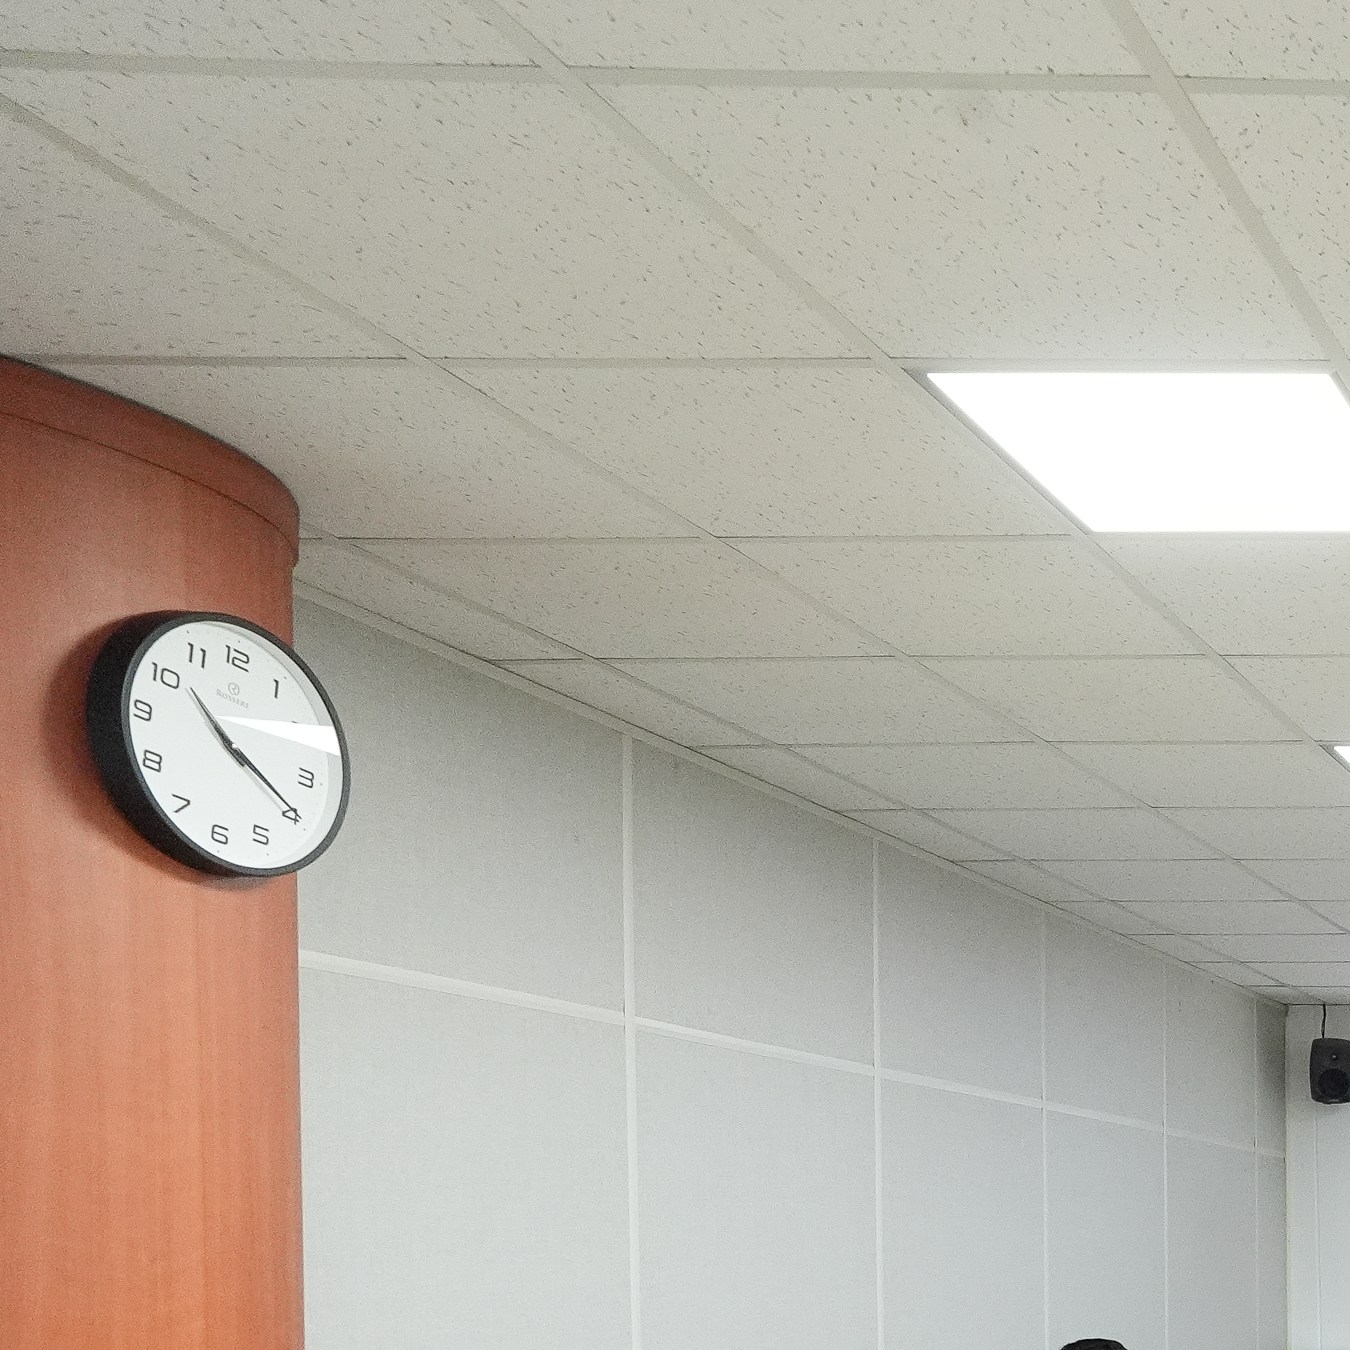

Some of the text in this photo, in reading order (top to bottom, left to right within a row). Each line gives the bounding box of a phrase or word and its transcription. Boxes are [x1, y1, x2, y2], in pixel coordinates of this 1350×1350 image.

[187, 642, 206, 668] 11
[226, 644, 250, 672] 12
[151, 662, 180, 690] 10
[272, 678, 280, 698] 1
[134, 700, 152, 721] 9
[142, 750, 162, 772] 8
[298, 768, 314, 788] 3
[172, 794, 190, 813] 7
[282, 807, 302, 825] 4
[211, 824, 229, 844] 6
[252, 824, 270, 845] 5
